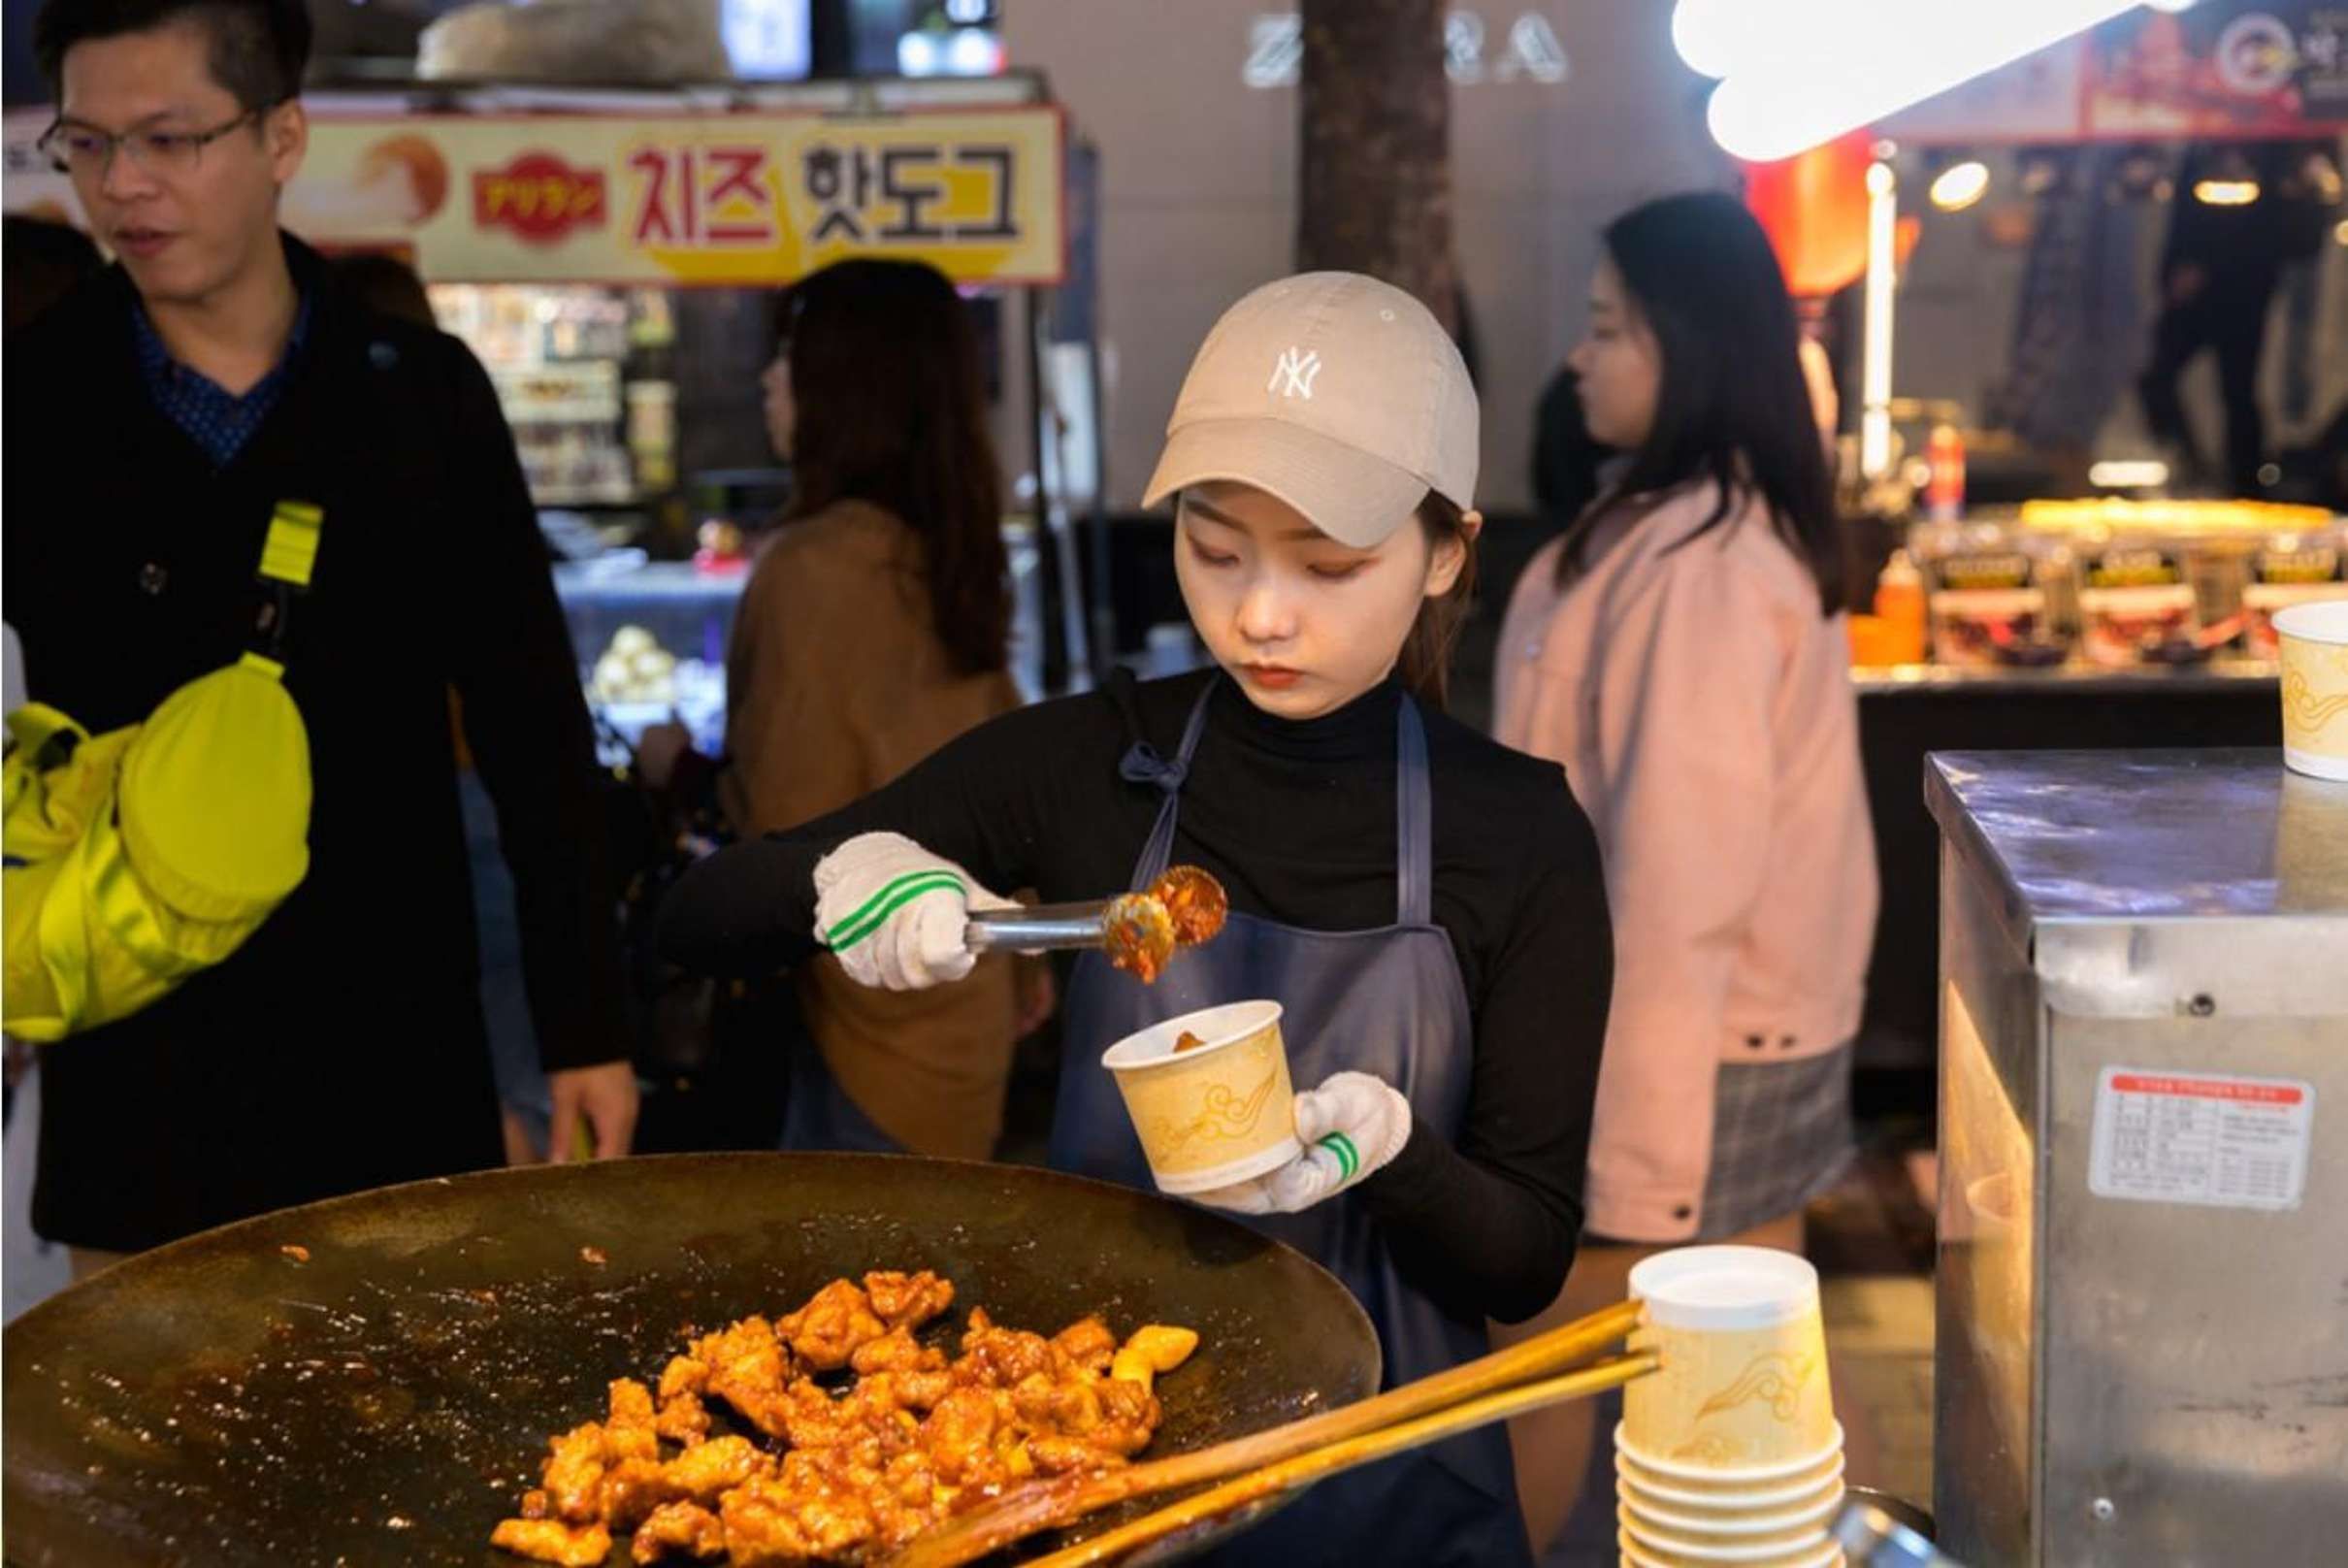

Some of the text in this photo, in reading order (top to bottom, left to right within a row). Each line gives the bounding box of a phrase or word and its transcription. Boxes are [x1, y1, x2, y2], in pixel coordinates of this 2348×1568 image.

[1244, 13, 1567, 86] ZRA
[628, 145, 1018, 245] 치즈 핫도그
[1267, 345, 1321, 399] NY
